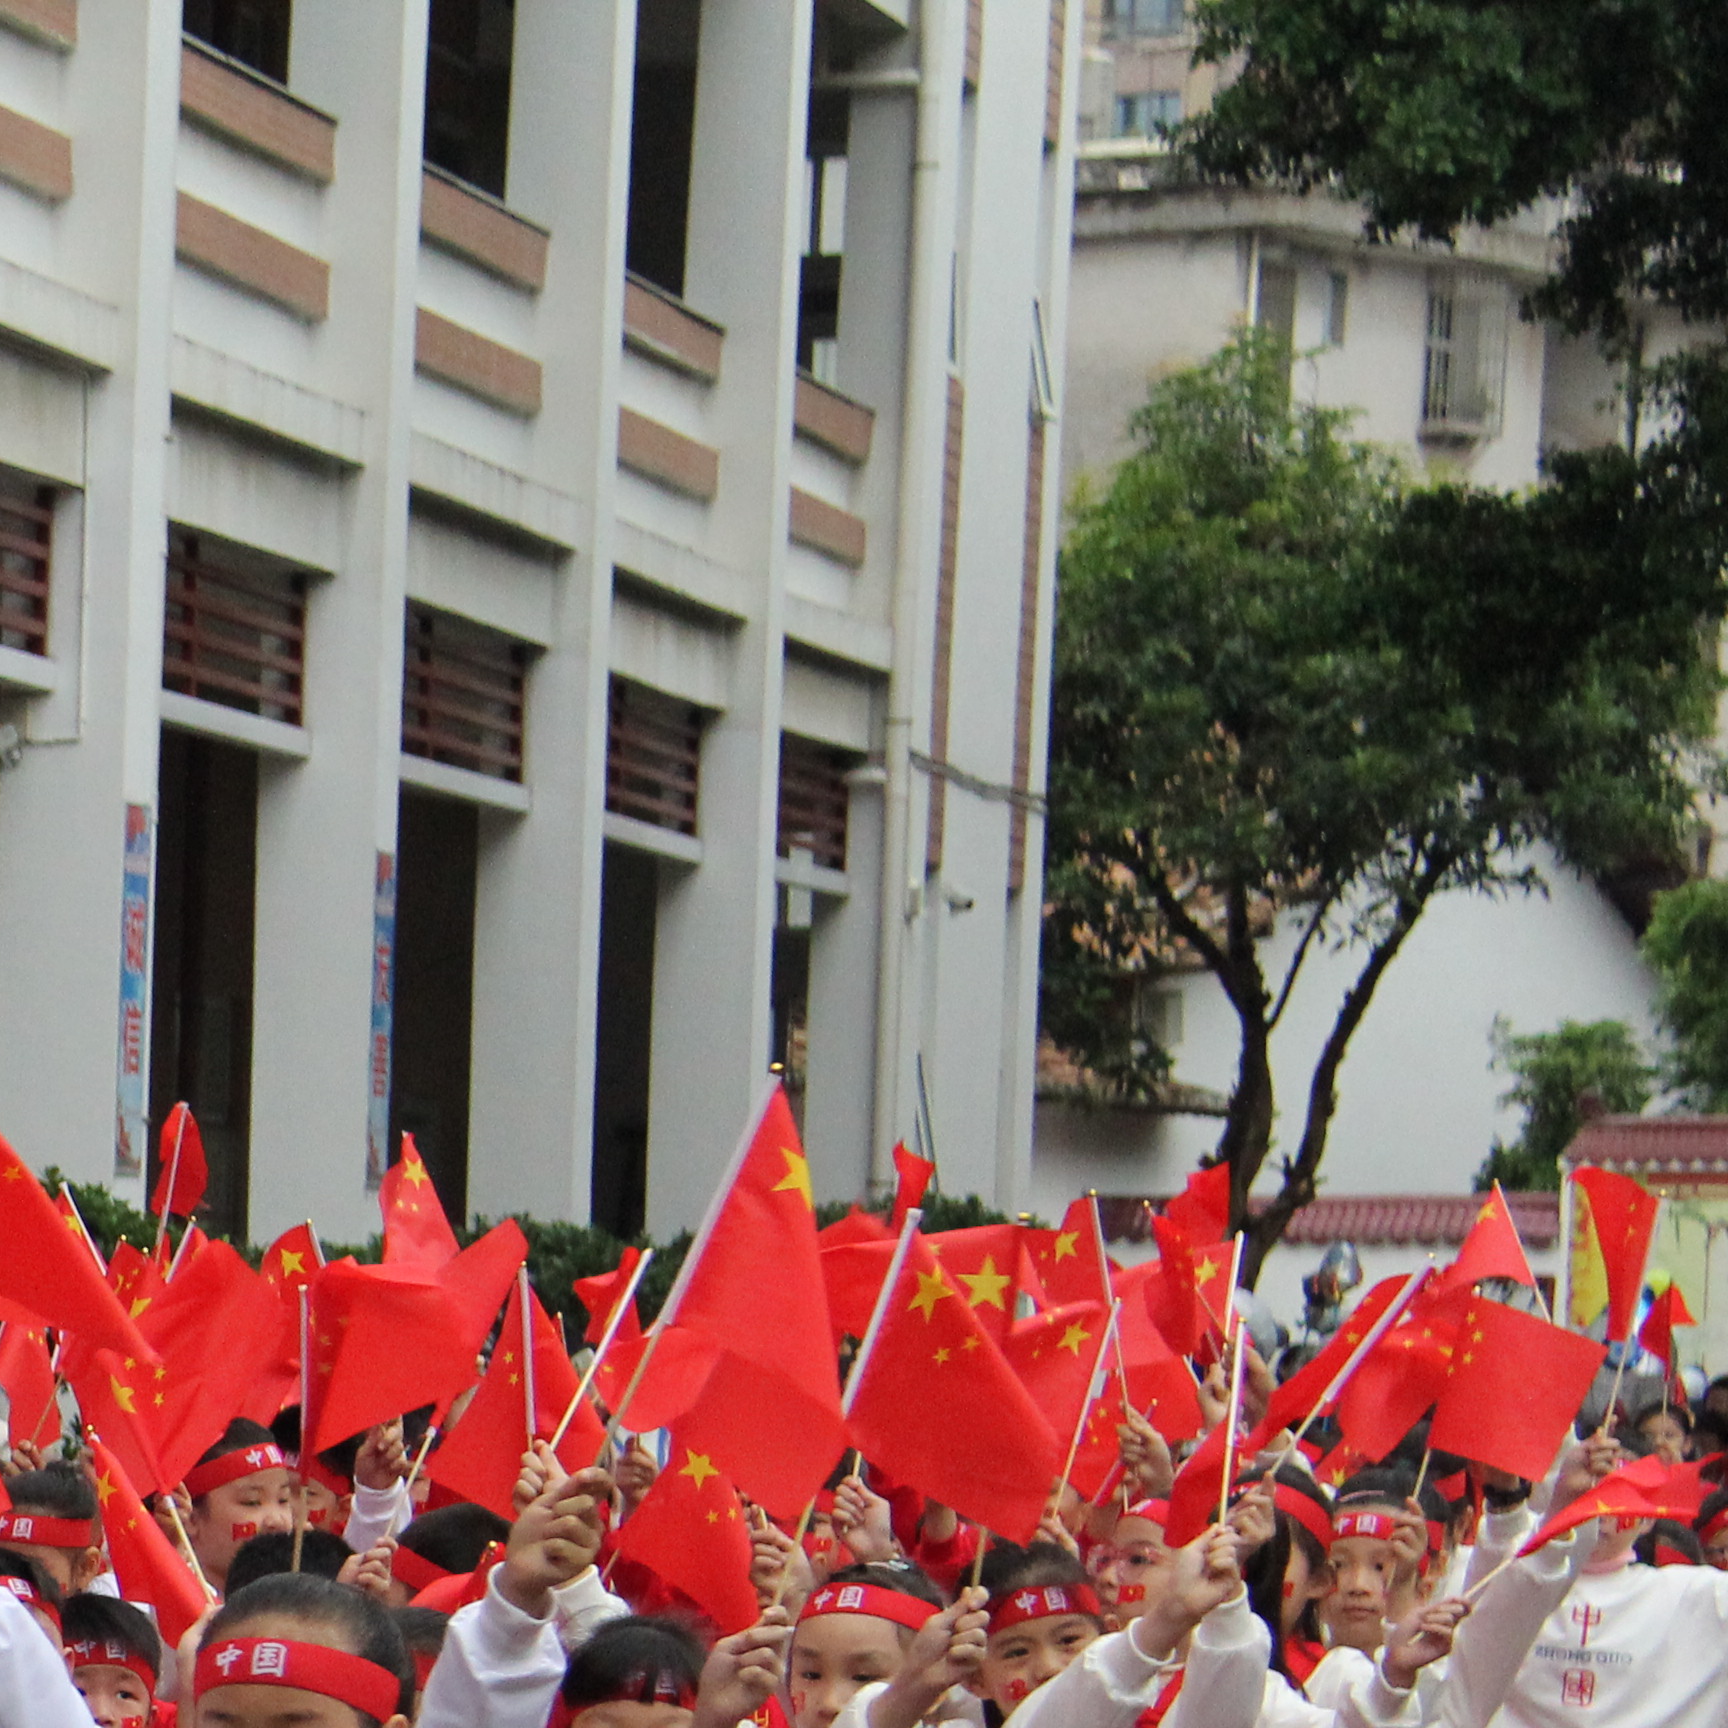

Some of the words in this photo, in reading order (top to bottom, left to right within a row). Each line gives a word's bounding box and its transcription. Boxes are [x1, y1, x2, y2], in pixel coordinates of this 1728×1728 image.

[813, 1585, 864, 1611] 中国
[1014, 1584, 1068, 1613] 中国
[215, 1640, 288, 1677] 中国
